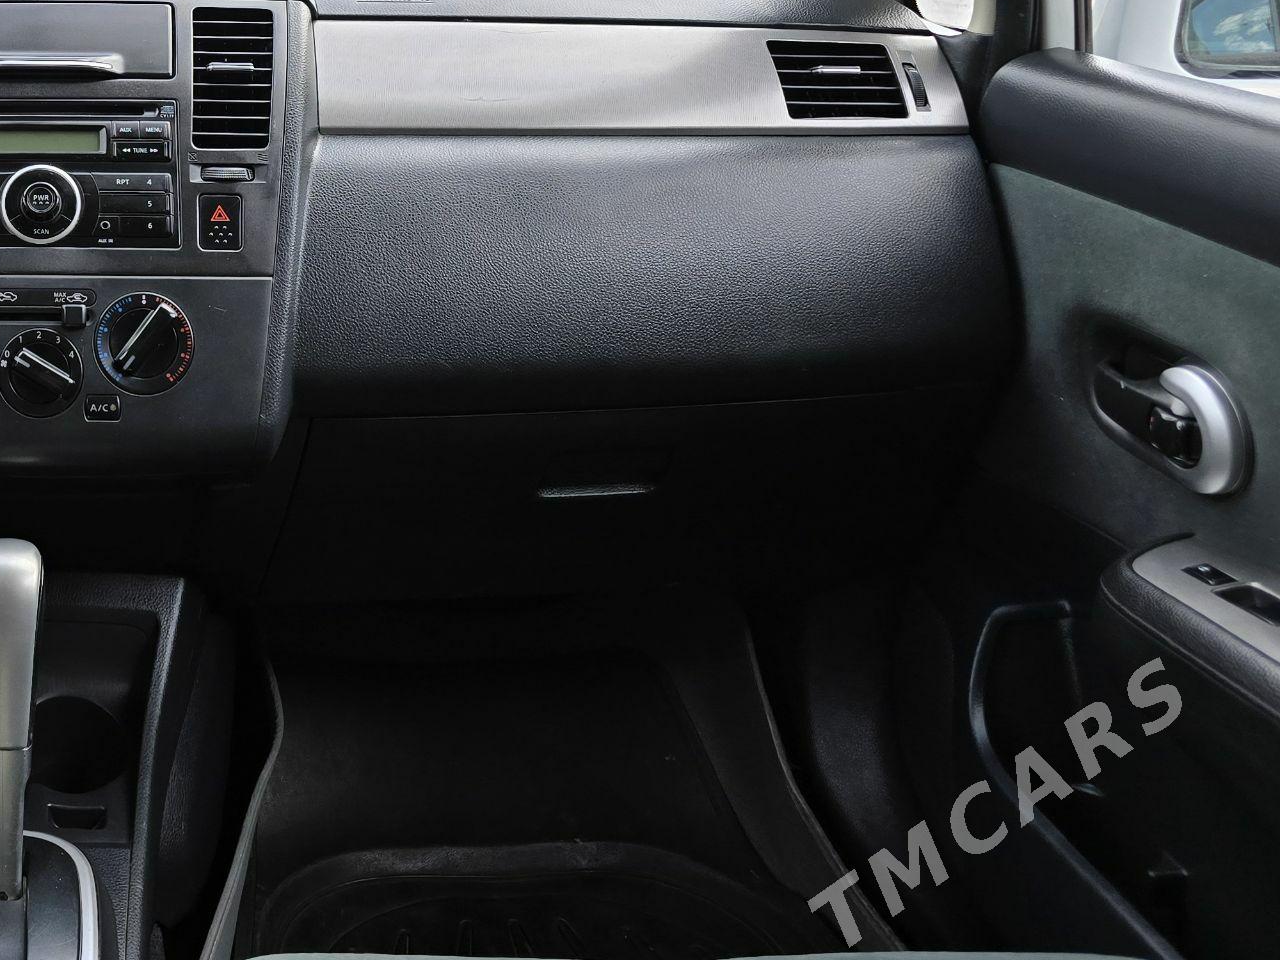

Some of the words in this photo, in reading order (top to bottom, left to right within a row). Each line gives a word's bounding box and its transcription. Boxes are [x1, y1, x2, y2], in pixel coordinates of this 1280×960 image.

[147, 200, 153, 208] 5
[147, 222, 153, 230] 6
[36, 331, 42, 339] 2
[55, 336, 61, 344] 3
[4, 349, 10, 358] 0
[68, 350, 75, 358] 4
[89, 404, 109, 413] A/C
